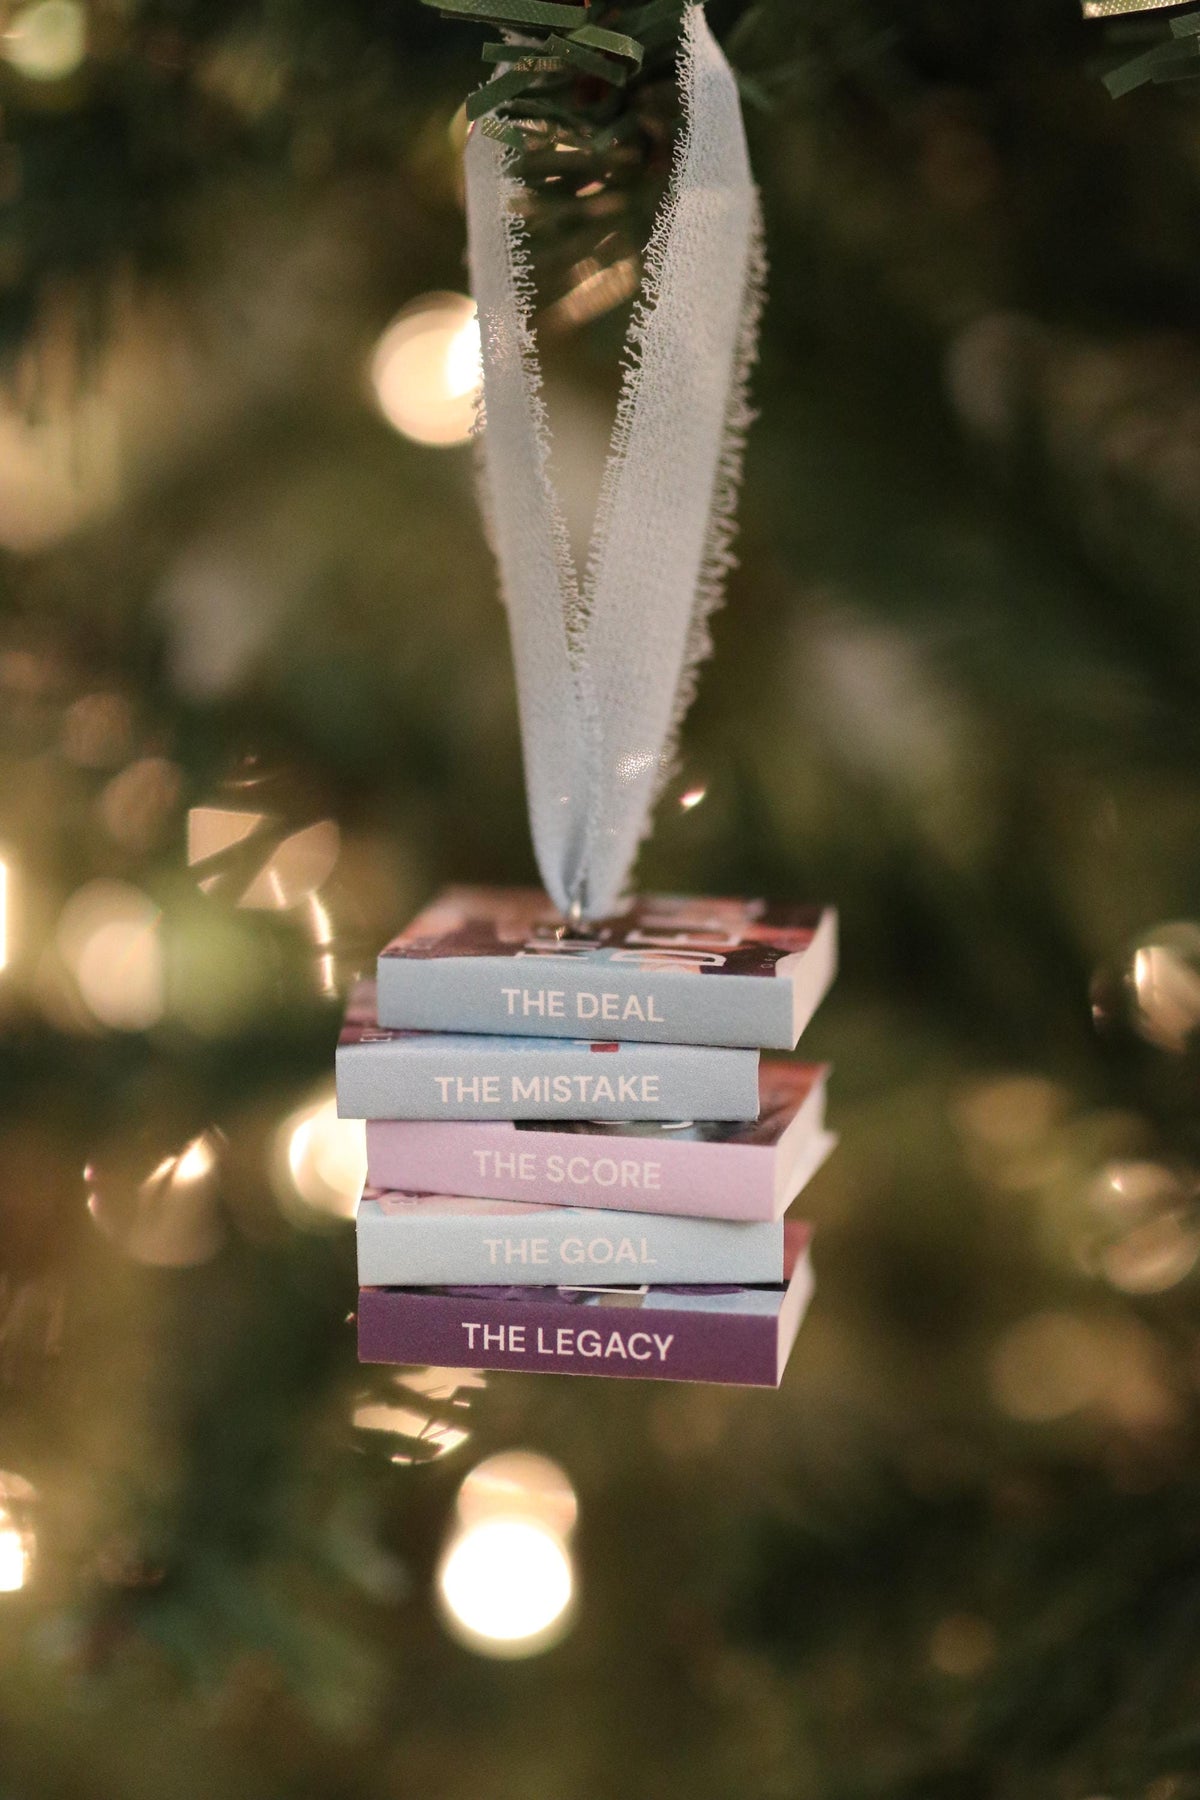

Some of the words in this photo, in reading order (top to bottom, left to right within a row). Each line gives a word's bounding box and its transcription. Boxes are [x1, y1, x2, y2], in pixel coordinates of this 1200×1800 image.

[500, 988, 566, 1018] THE
[577, 993, 664, 1023] DEAL
[434, 1076, 501, 1103] THE
[510, 1075, 660, 1103] MISTAKE
[473, 1149, 537, 1182] THE
[545, 1154, 661, 1190] SCORE
[483, 1237, 549, 1265] THE
[559, 1237, 658, 1265] GOAL
[461, 1322, 526, 1353] THE
[537, 1327, 675, 1362] LEGACY
